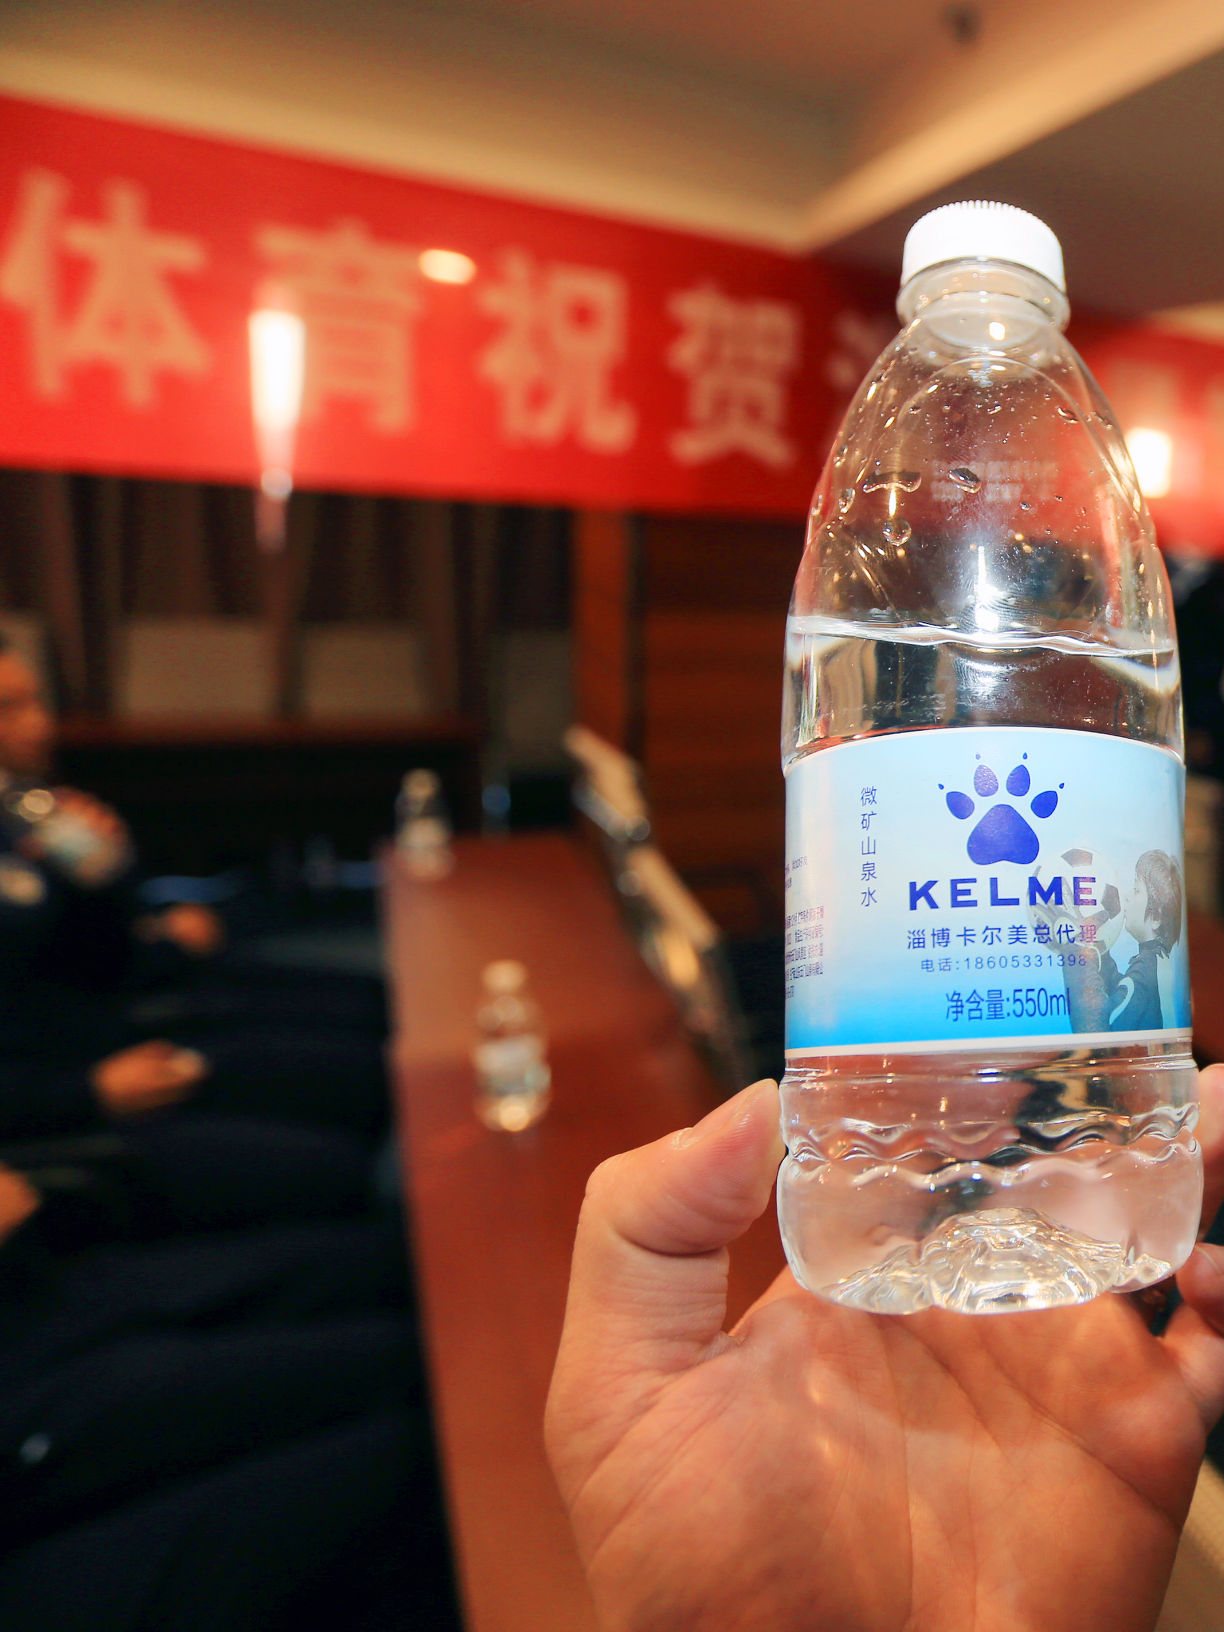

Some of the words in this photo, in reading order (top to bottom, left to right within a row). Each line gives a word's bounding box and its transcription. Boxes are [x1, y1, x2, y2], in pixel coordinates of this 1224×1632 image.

[0, 164, 852, 472] 体育祝贺
[860, 785, 878, 908] 微矿山泉水
[908, 876, 1097, 911] KELME
[907, 923, 1099, 950] 淄博卡尔美总代理
[945, 986, 1072, 1022] 净含量:550ml
